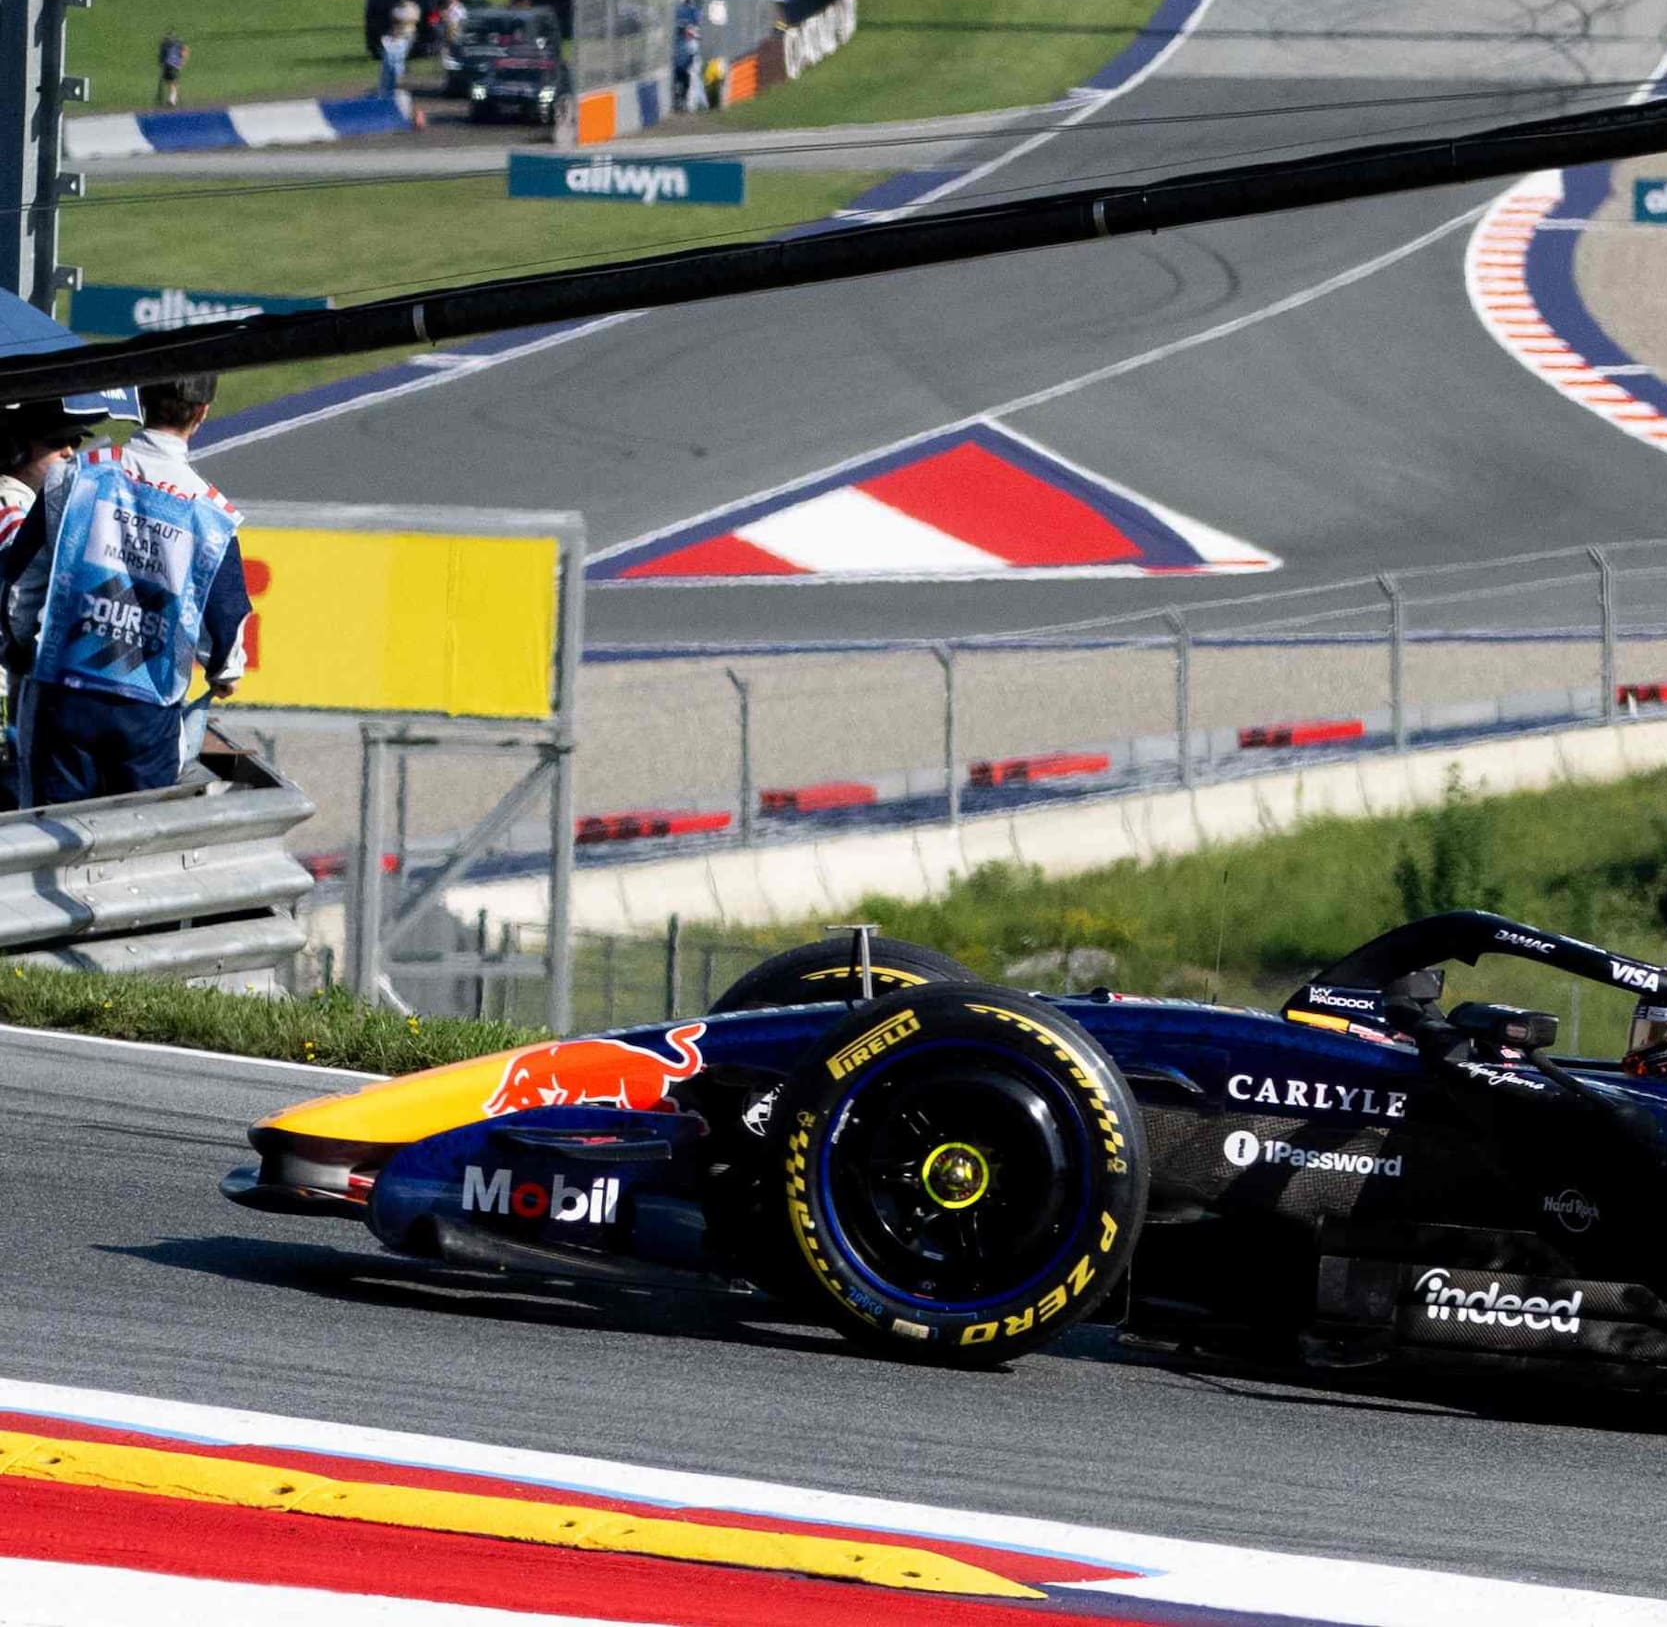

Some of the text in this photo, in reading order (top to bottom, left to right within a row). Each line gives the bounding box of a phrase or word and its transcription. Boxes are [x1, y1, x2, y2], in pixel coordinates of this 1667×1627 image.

[566, 156, 687, 205] allwyn
[1494, 929, 1556, 954] DAMAC
[1309, 986, 1333, 998] MY
[1610, 960, 1661, 993] VISA
[1309, 993, 1375, 1011] PADDOCK
[826, 1009, 921, 1080] PIRELLI
[1228, 1074, 1407, 1118] CARLYLE
[1263, 1140, 1402, 1177] 1Password
[462, 1166, 619, 1224] Mobil
[1543, 1196, 1573, 1213] Hard
[960, 1254, 1096, 1345] ZERO
[1414, 1267, 1583, 1334] indeed
